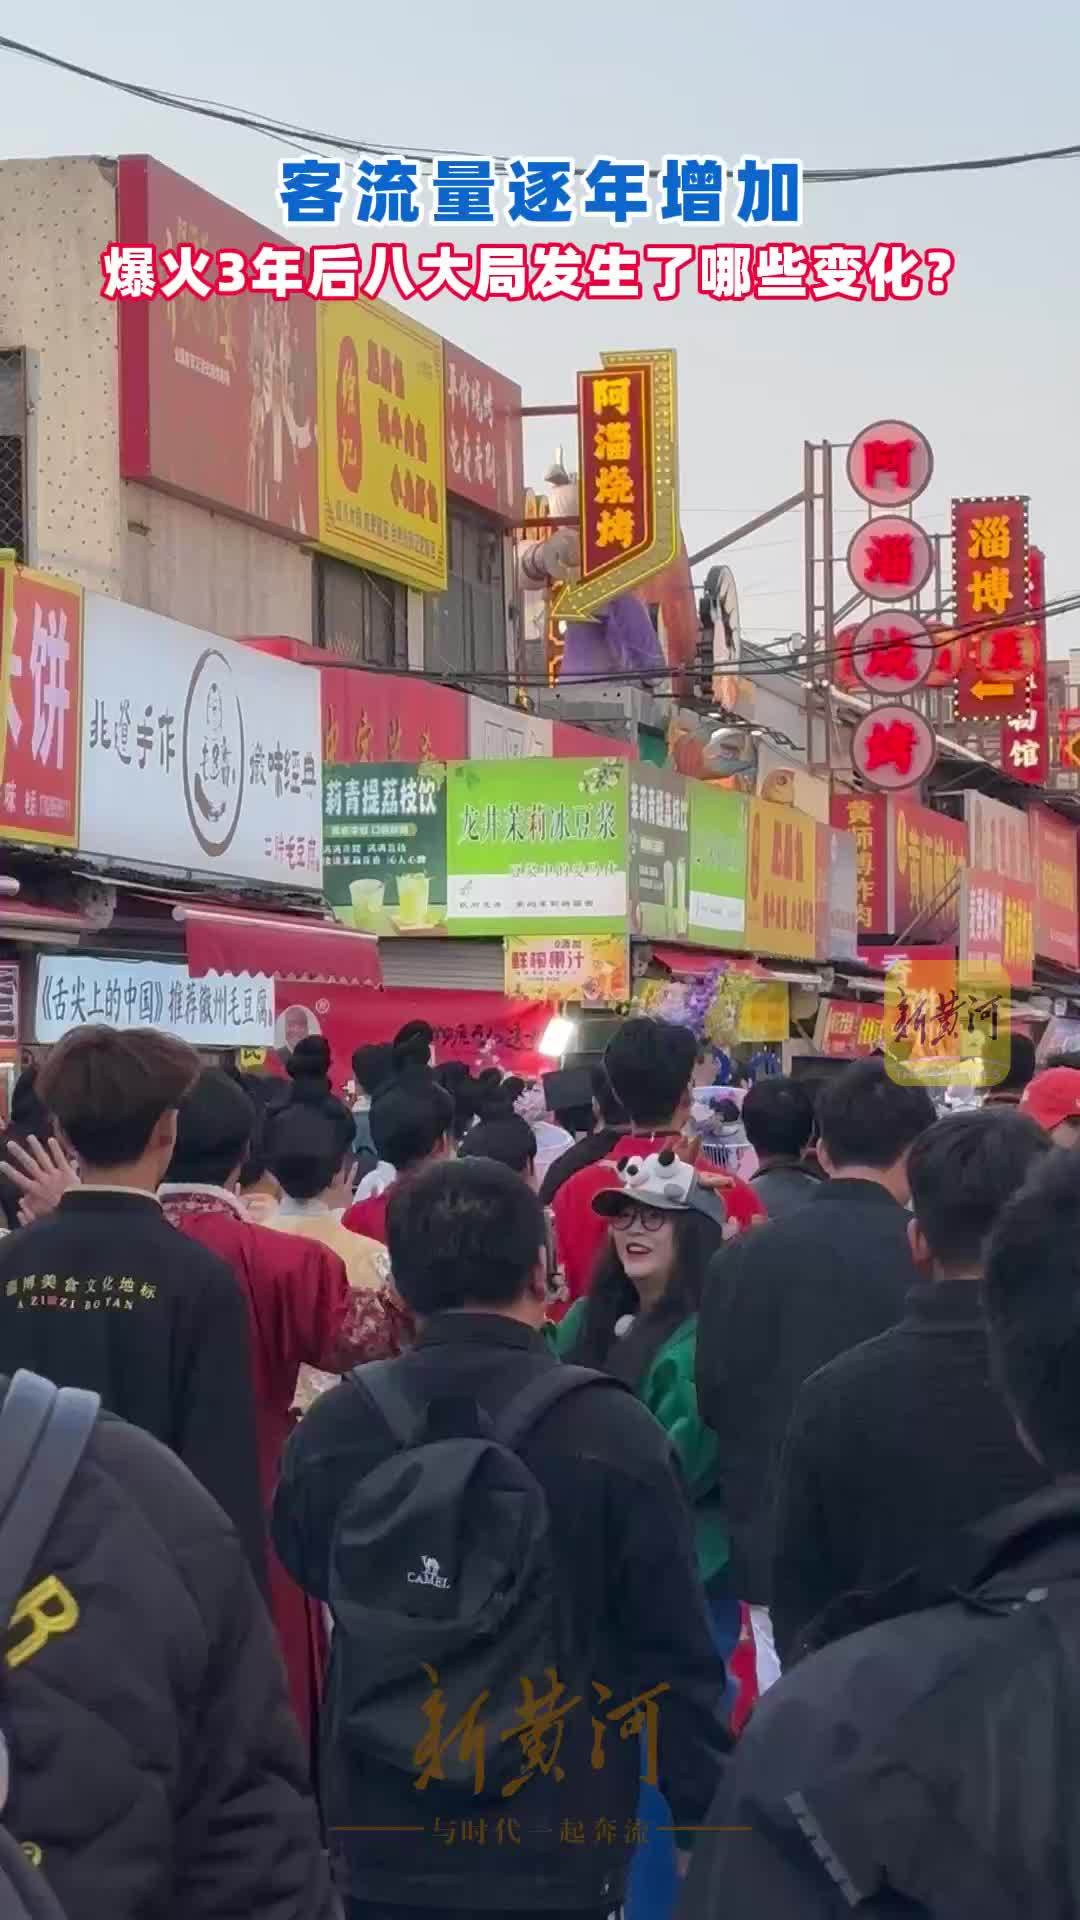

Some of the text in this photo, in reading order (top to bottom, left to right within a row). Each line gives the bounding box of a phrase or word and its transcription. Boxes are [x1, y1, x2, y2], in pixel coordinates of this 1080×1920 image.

[592, 377, 635, 549] 阿淄烧烤
[967, 514, 1014, 615] 淄博
[460, 800, 618, 843] 龙井茉莉冰豆浆
[511, 951, 585, 970] 鲜榨果汁
[407, 1571, 451, 1589] CAMEL
